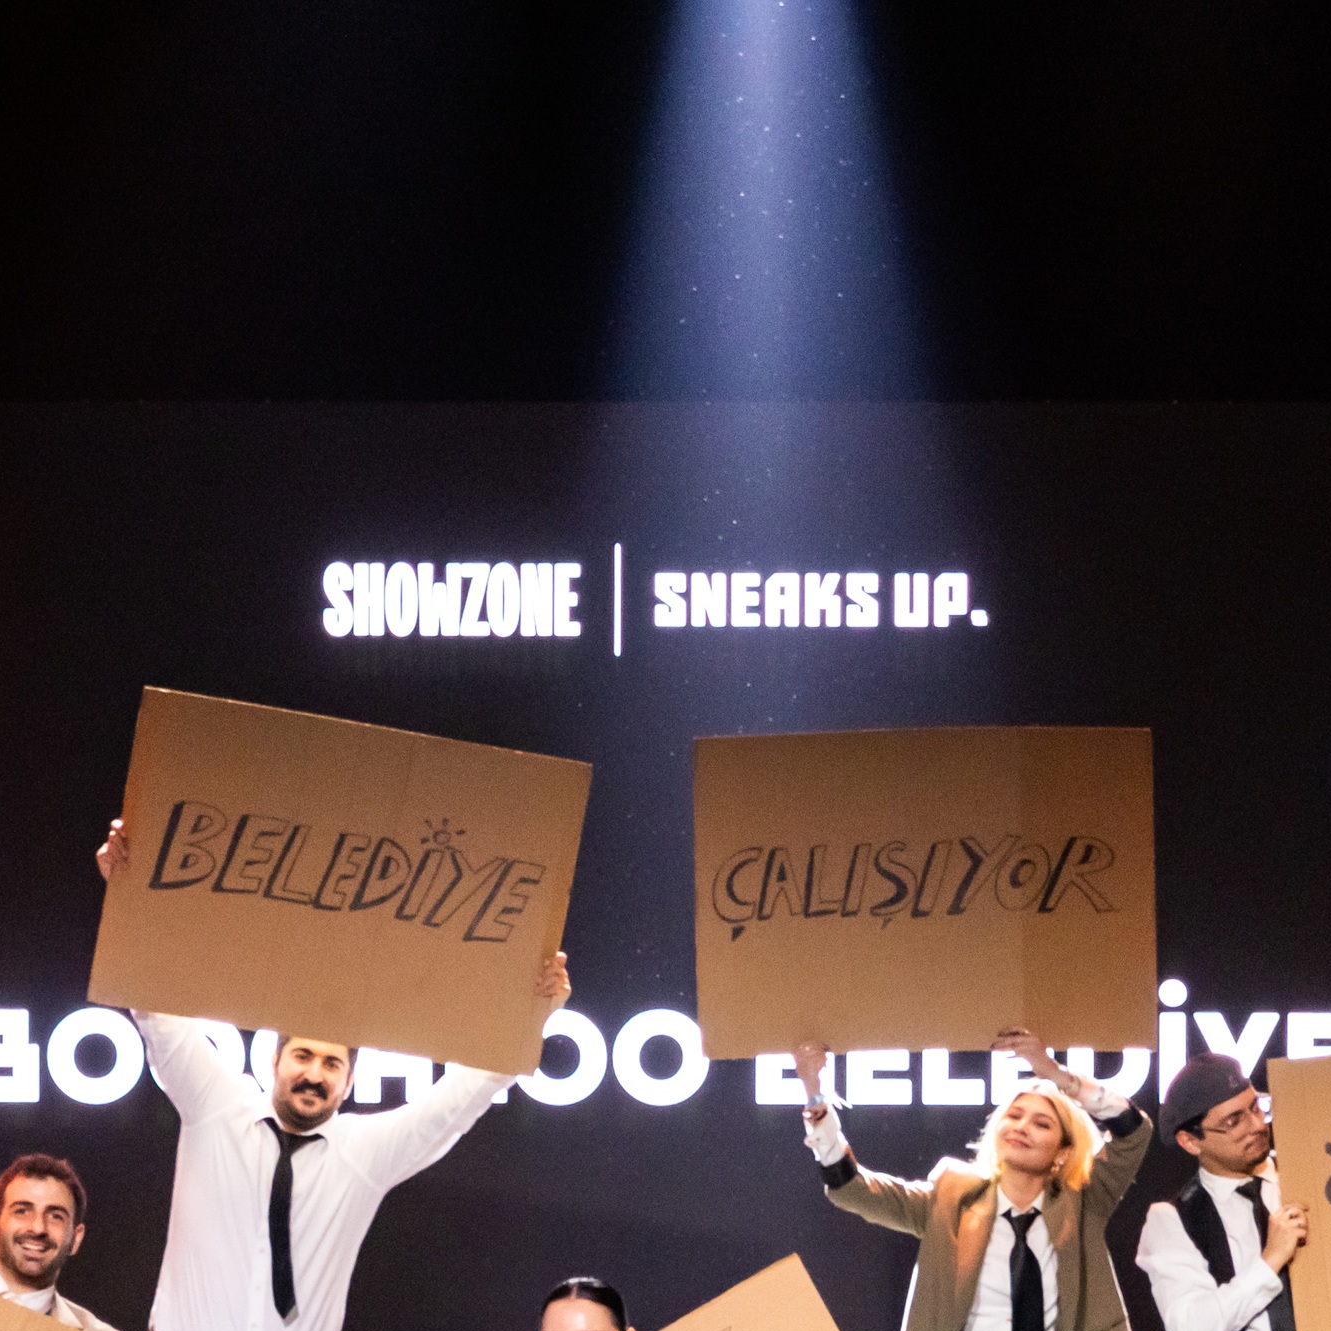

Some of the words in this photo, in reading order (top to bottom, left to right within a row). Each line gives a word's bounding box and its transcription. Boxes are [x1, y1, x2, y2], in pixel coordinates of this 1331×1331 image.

[322, 561, 581, 637] SHOWZONE
[654, 572, 879, 627] SNEAKS
[893, 572, 989, 627] UP.
[149, 801, 546, 943] BELEDİYE
[712, 833, 1120, 942] ÇALIŞIYOR
